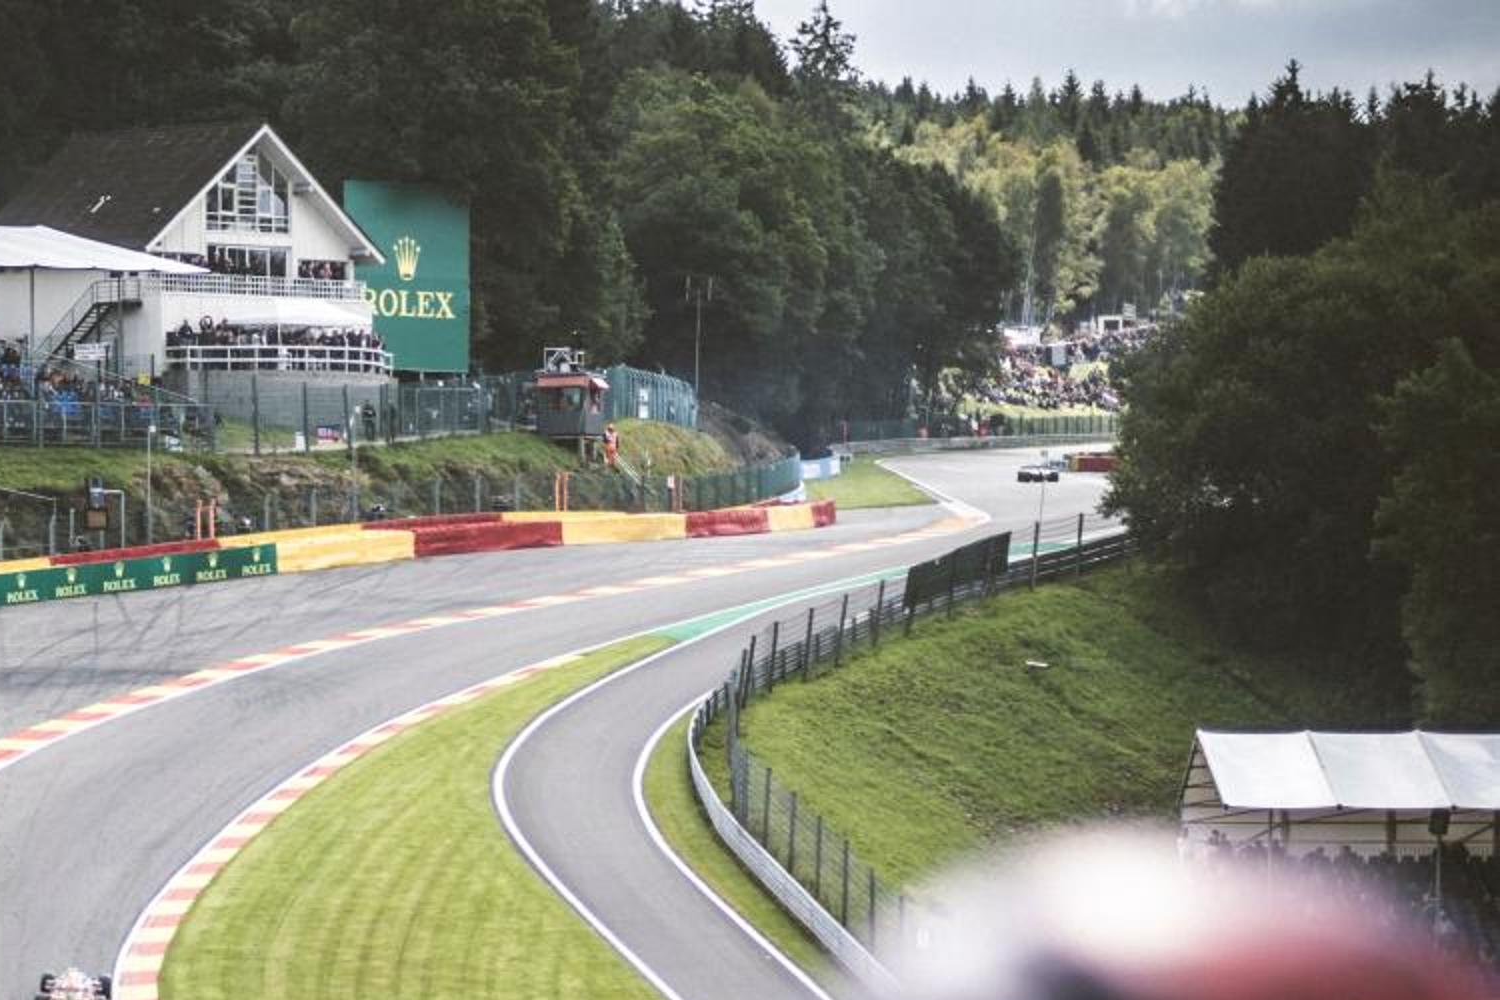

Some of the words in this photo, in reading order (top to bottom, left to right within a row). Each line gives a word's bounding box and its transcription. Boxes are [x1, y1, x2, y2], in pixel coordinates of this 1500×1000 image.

[196, 570, 227, 582] ROLEX
[241, 563, 271, 576] ROLEX
[103, 578, 135, 592] ROLEX
[153, 573, 180, 586] ROLEX
[6, 590, 39, 604] ROLEX
[55, 583, 86, 598] ROLEX
